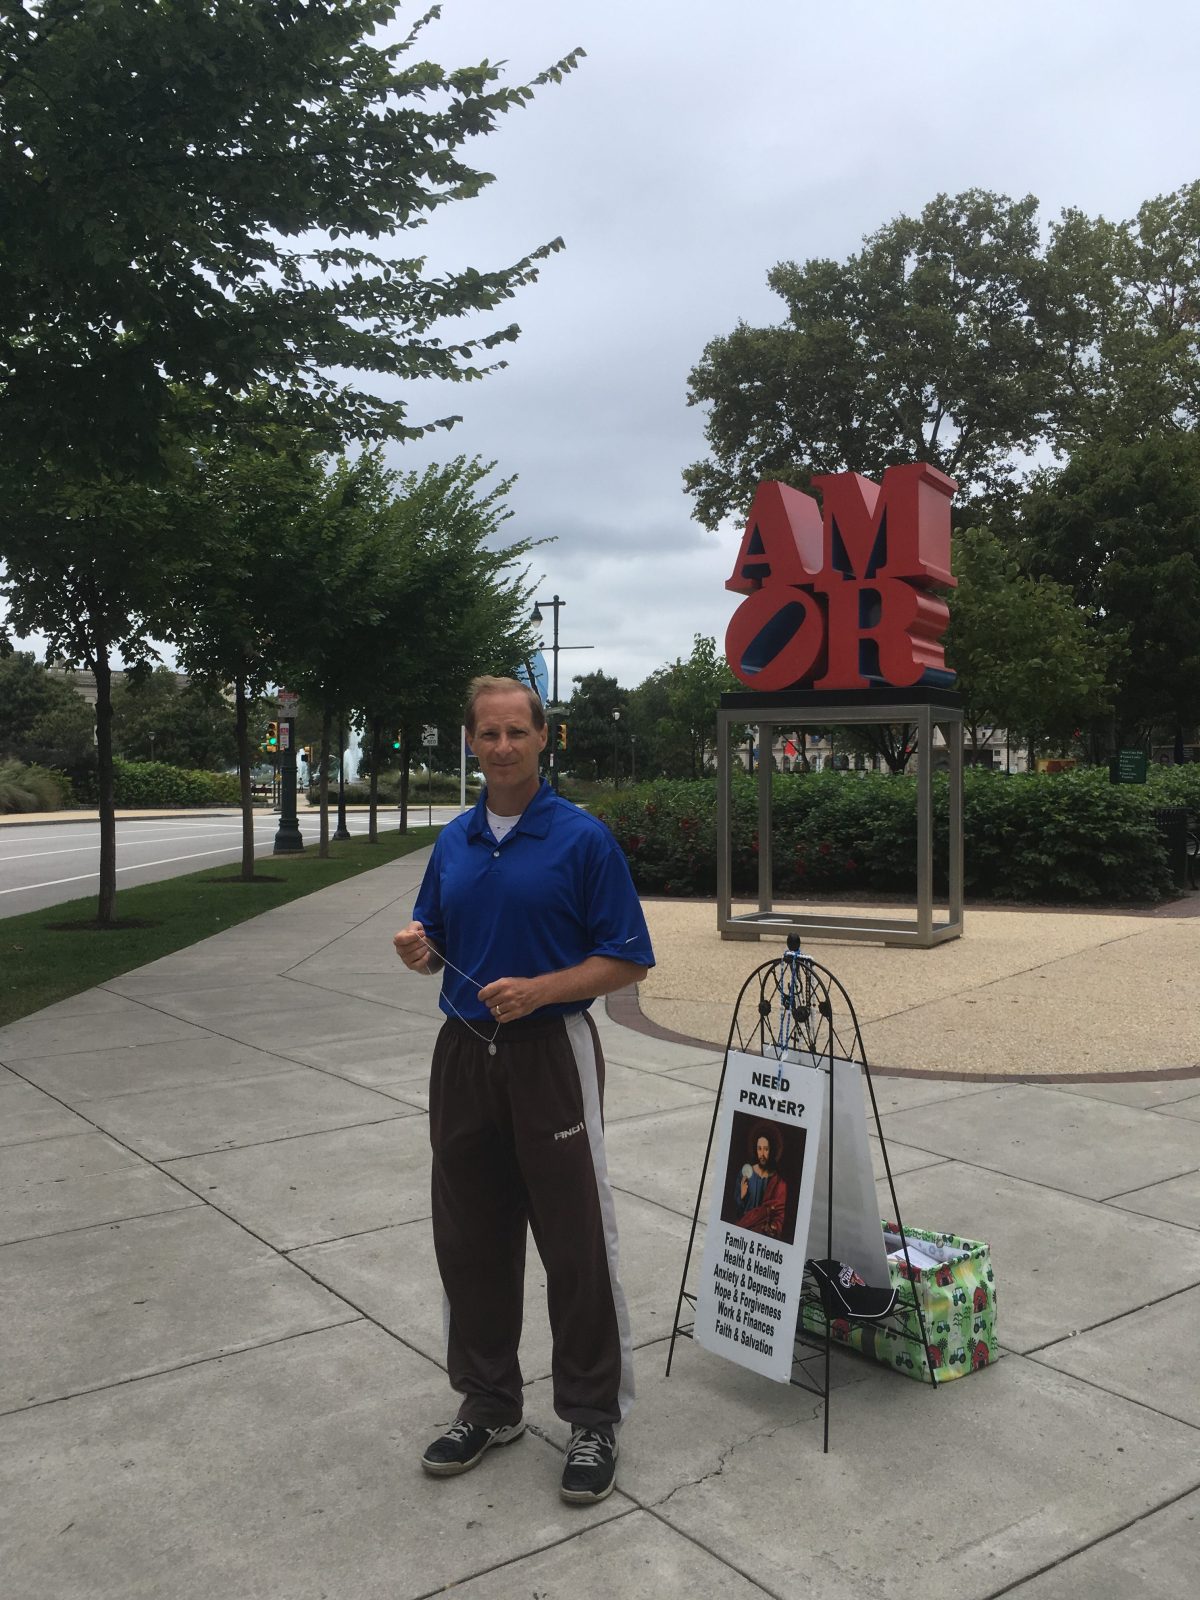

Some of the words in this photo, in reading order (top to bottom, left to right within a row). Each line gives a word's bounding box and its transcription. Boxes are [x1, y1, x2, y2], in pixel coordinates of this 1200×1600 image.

[725, 462, 955, 591] AM
[725, 578, 942, 692] OR
[751, 1071, 790, 1092] NEED
[739, 1089, 805, 1117] PRAYER?
[724, 1231, 748, 1255] Family
[749, 1240, 755, 1254] &
[756, 1242, 783, 1265] Friends
[713, 1263, 739, 1288] Anxiety
[740, 1273, 746, 1288] &
[747, 1275, 786, 1304] Depression
[723, 1249, 746, 1269] Health
[746, 1257, 752, 1272] &
[753, 1260, 780, 1285] Healing
[714, 1281, 732, 1301] Hope
[732, 1288, 738, 1303] &
[740, 1291, 782, 1321] Forgiveness
[717, 1300, 735, 1320] Work
[735, 1308, 742, 1323] &
[742, 1311, 775, 1337] Finances
[715, 1319, 733, 1339] Faith
[733, 1327, 739, 1342] &
[740, 1330, 774, 1357] Salvation
